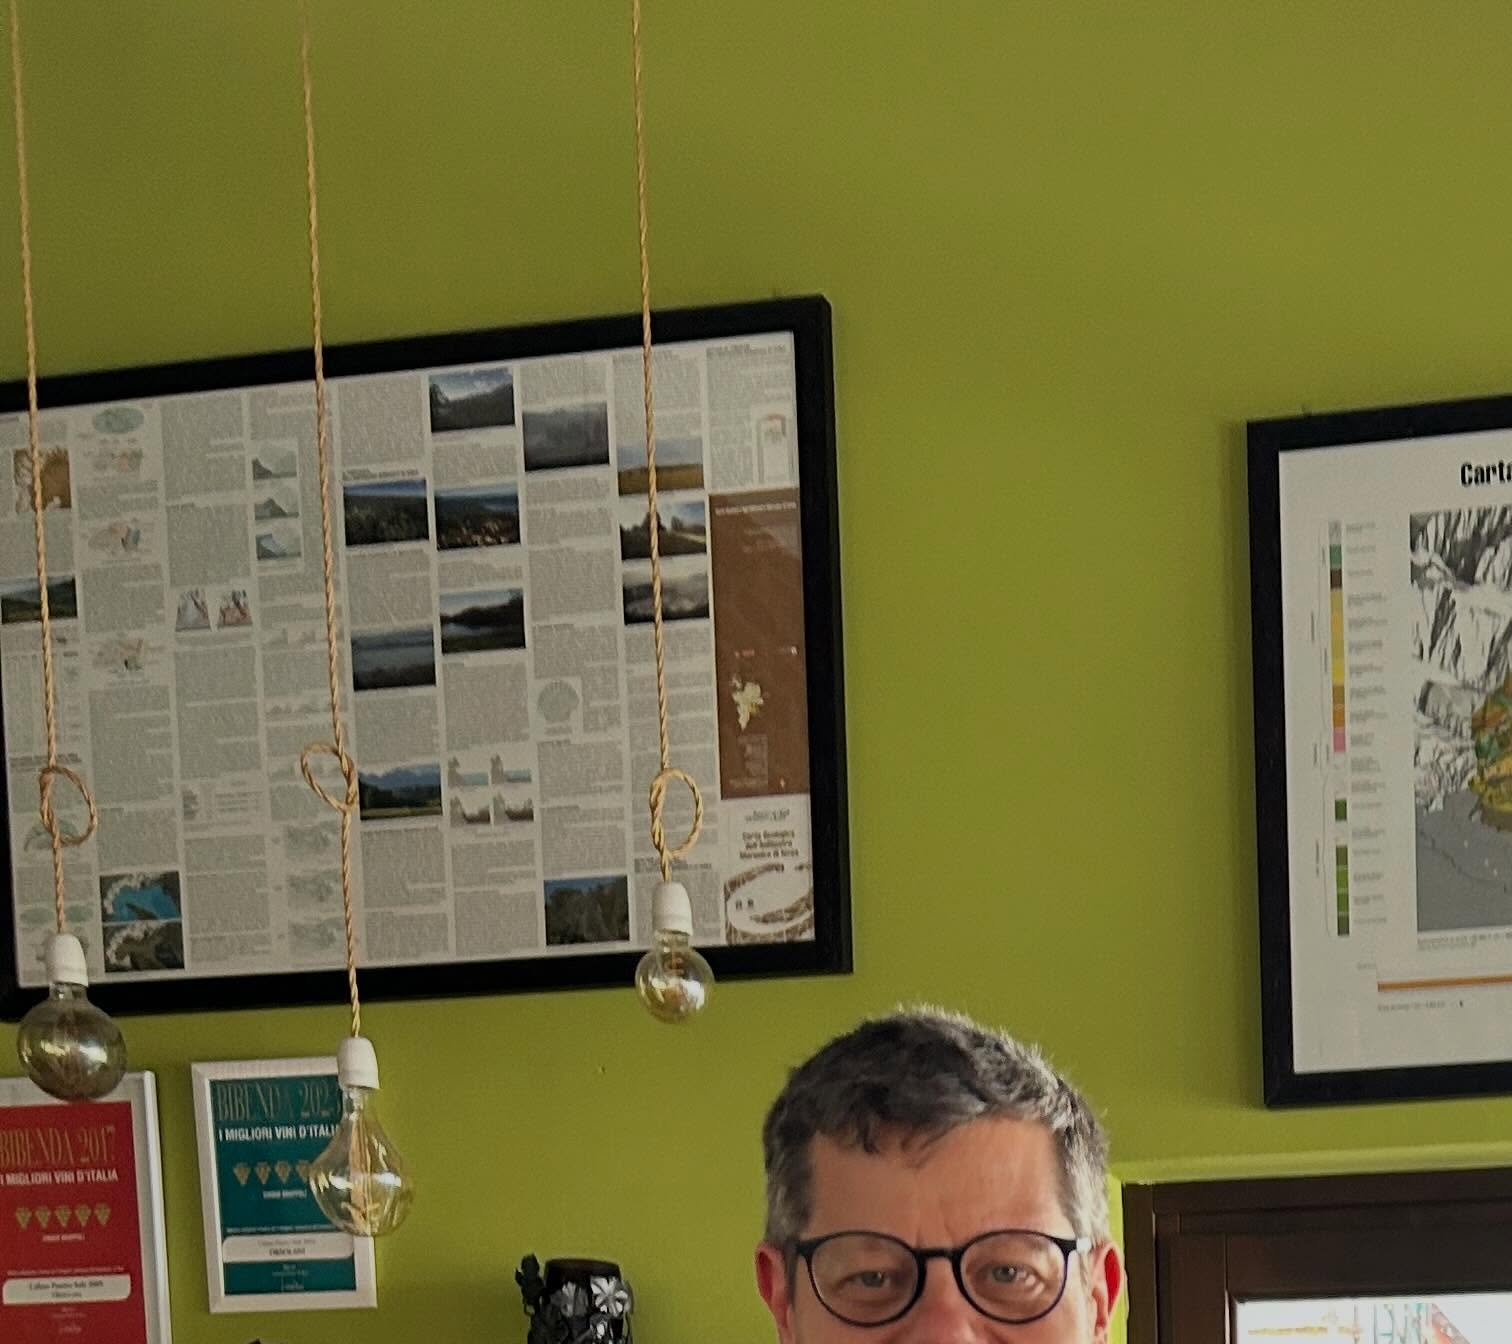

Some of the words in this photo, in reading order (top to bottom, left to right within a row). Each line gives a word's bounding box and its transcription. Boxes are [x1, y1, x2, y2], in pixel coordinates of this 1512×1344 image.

[216, 1081, 295, 1121] BIBENDA
[225, 1126, 273, 1141] MIGLIORI
[274, 1124, 297, 1140] VINI
[0, 1127, 75, 1168] BIBENDA
[5, 1171, 52, 1186] MIGLIORI
[53, 1169, 75, 1184] VINI
[76, 1167, 119, 1183] D'ITALIA
